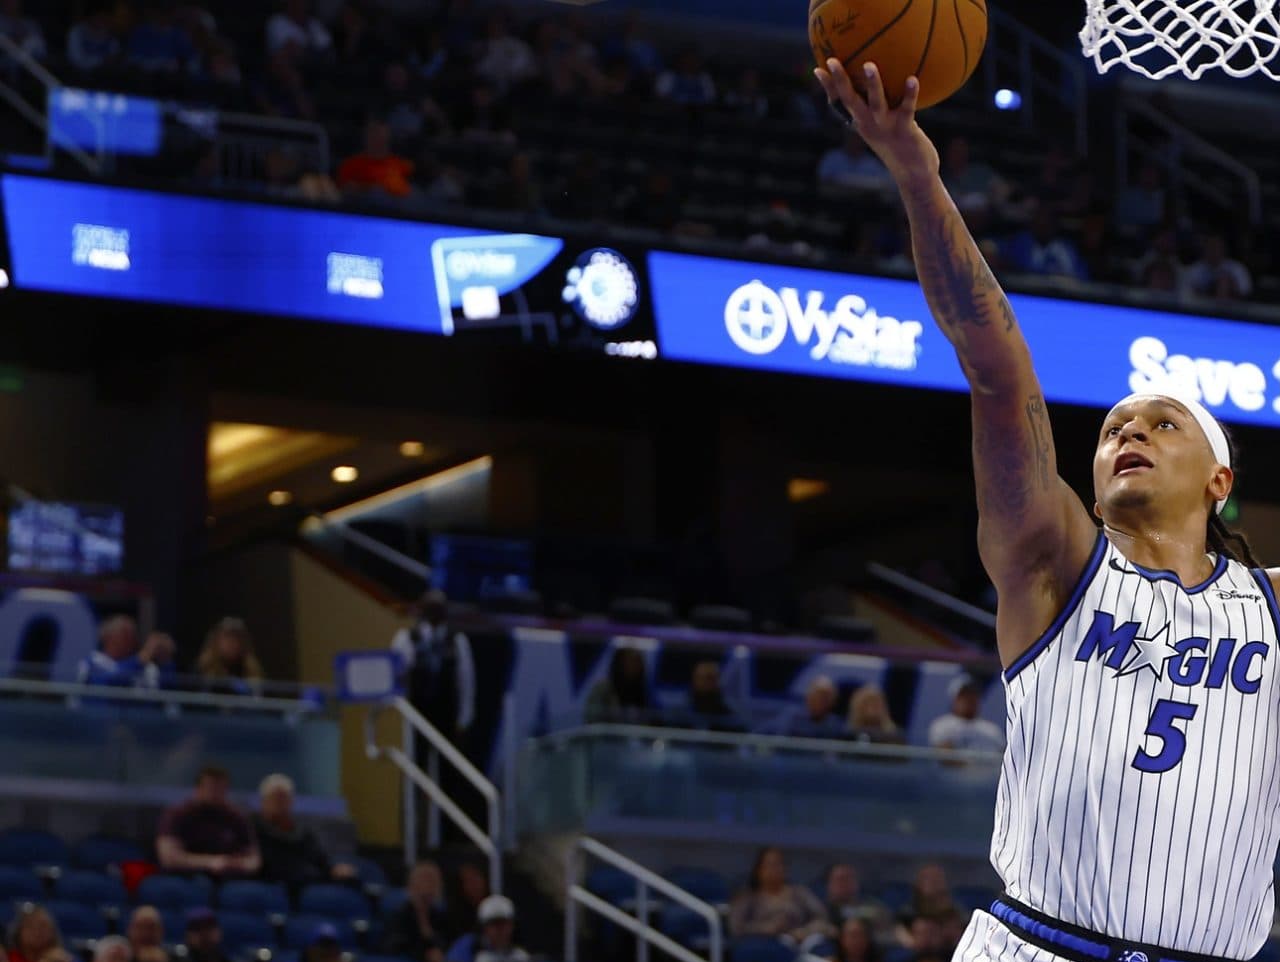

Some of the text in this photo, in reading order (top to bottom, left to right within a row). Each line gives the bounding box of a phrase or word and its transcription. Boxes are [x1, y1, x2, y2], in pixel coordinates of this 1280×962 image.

[780, 286, 923, 360] VyStar
[1129, 336, 1267, 411] Save
[1212, 589, 1262, 603] Disney
[1131, 698, 1199, 774] 5
